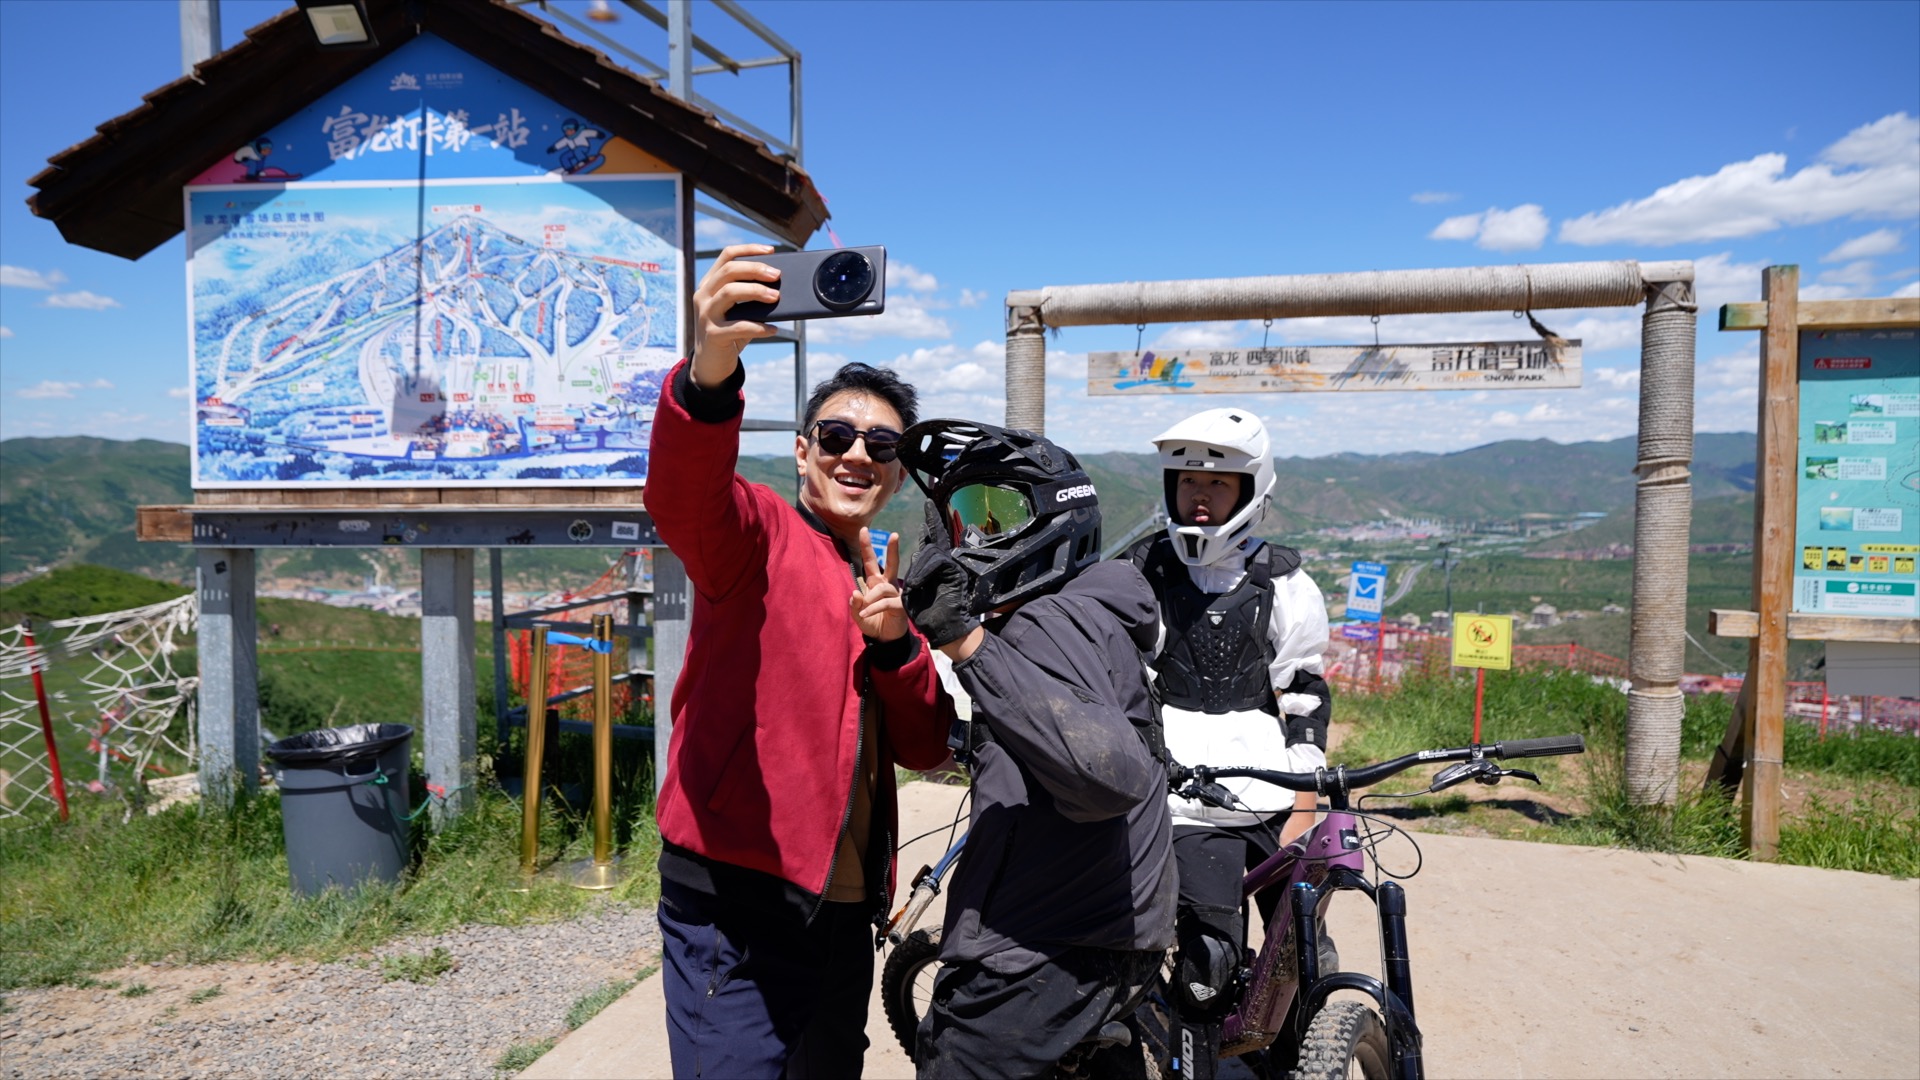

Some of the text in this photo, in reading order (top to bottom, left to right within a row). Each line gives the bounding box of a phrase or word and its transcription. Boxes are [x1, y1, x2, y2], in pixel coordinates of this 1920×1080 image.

[322, 105, 530, 160] 富龙打卡第一站
[1209, 351, 1240, 366] 富龙
[1483, 374, 1516, 382] SNOW
[1518, 374, 1546, 382] PARK
[1182, 1028, 1194, 1080] COM
